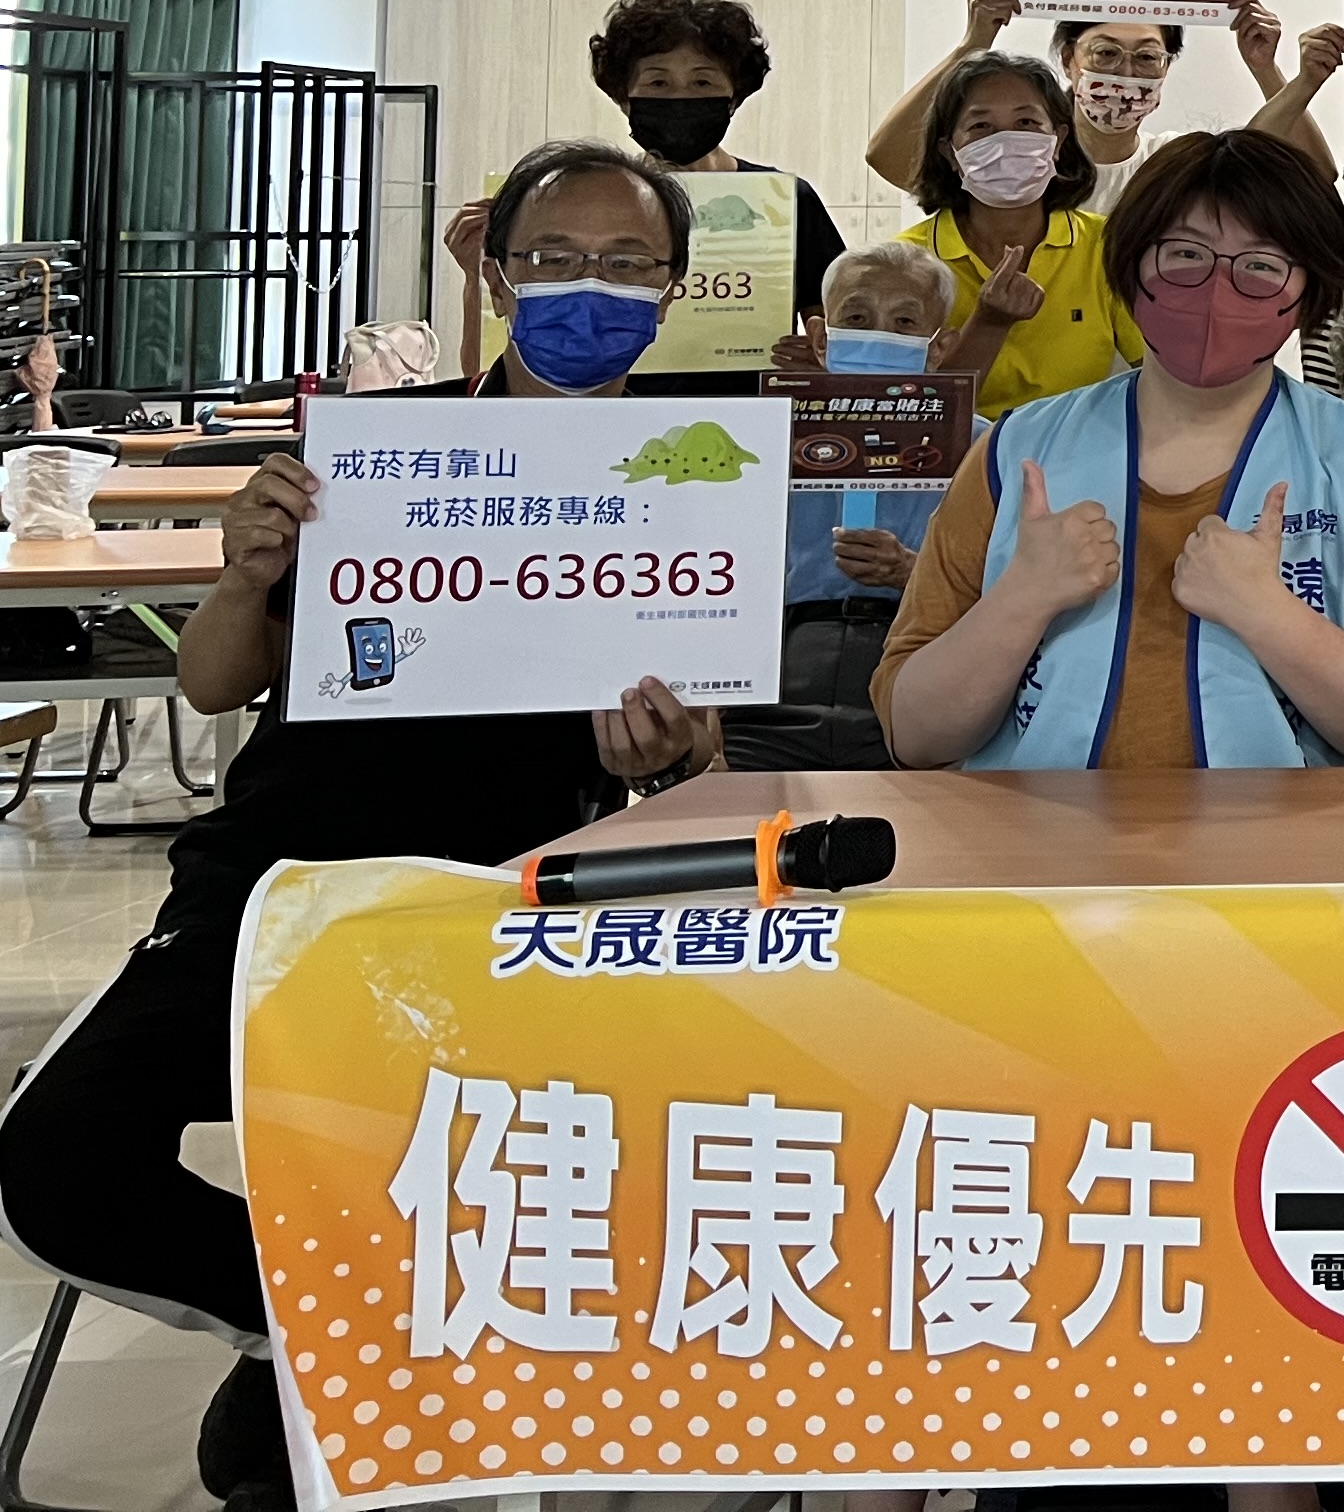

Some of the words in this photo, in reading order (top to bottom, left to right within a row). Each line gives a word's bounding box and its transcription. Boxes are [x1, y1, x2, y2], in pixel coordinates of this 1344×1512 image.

[1109, 5, 1219, 17] 0800-63-63-63
[331, 448, 517, 480] 戒菸有靠山
[869, 456, 898, 466] NO
[405, 495, 651, 529] 戒菸服務專線：
[329, 550, 736, 606] 0800-636363
[499, 906, 841, 970] 天晟醫院
[389, 1066, 1206, 1360] 健康優先
